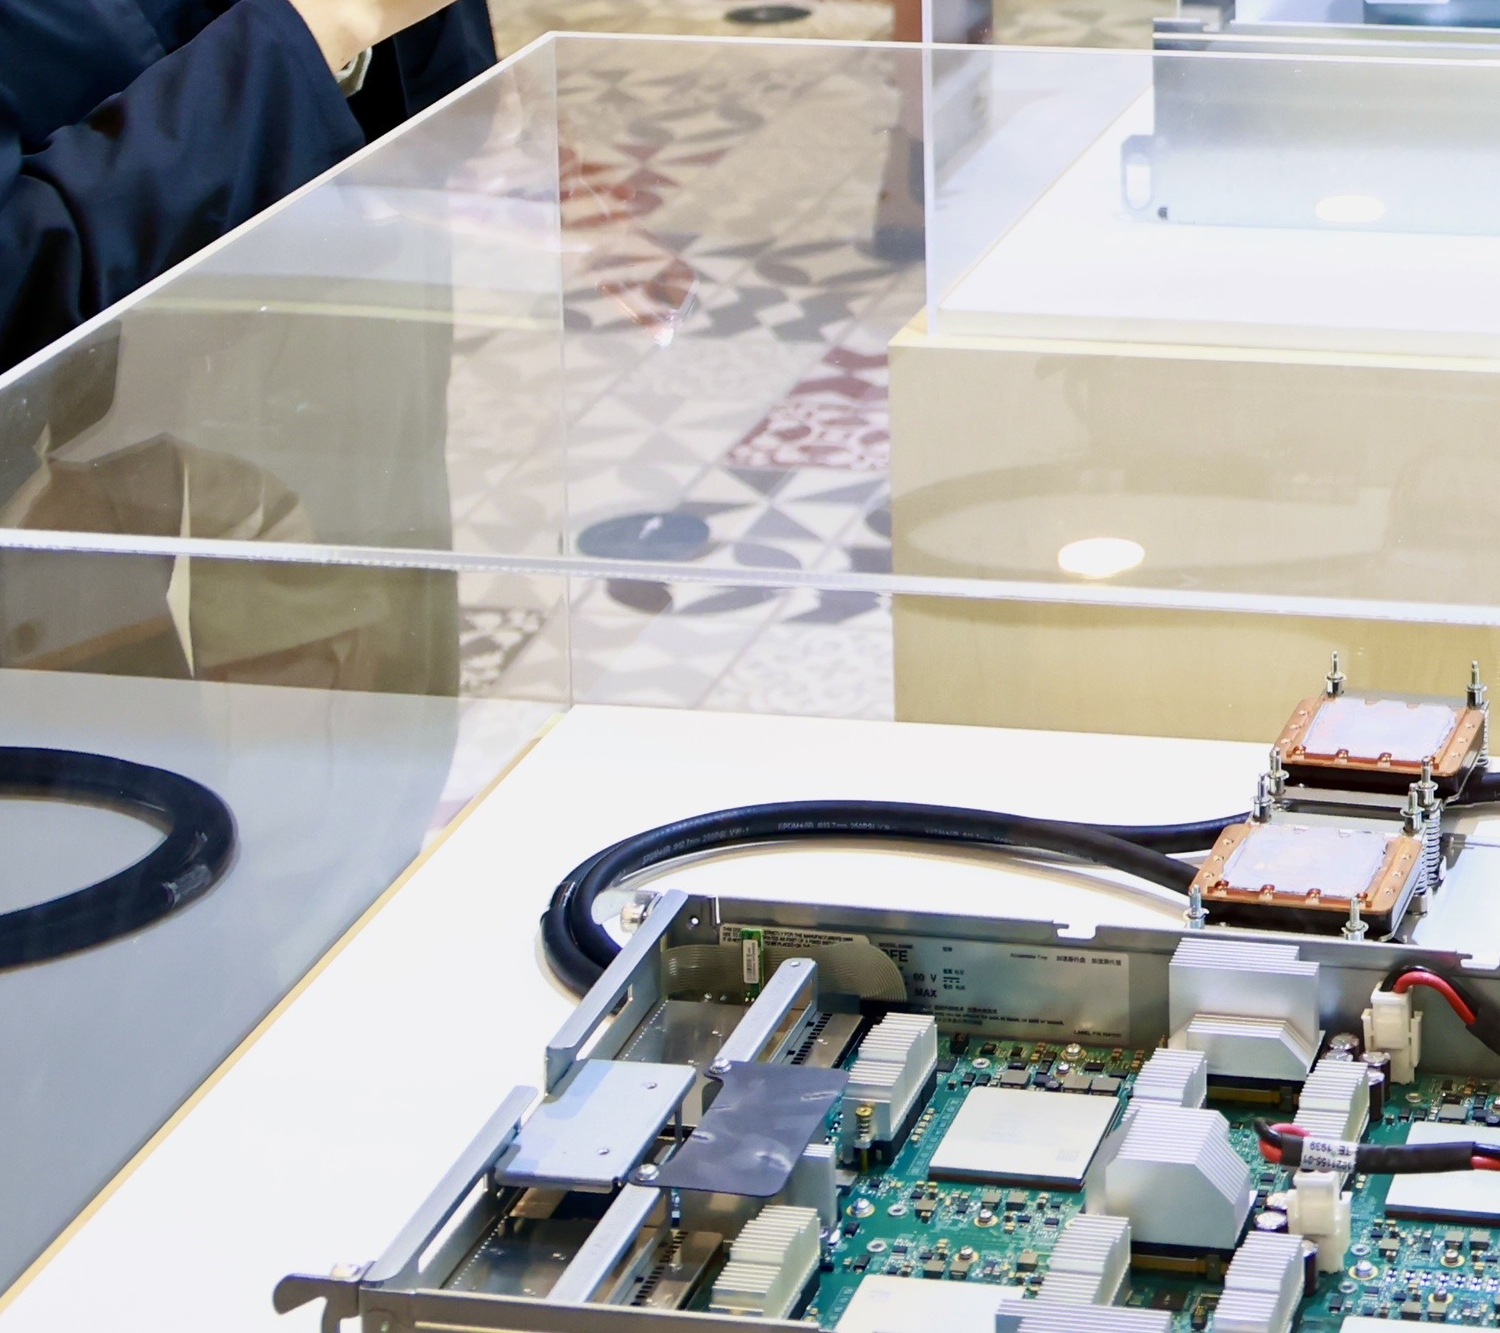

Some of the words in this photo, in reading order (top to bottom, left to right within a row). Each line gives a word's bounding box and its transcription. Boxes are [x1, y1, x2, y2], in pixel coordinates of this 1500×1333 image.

[914, 987, 938, 998] MAX
[1309, 1141, 1333, 1153] 1939
[1338, 1145, 1352, 1157] TE
